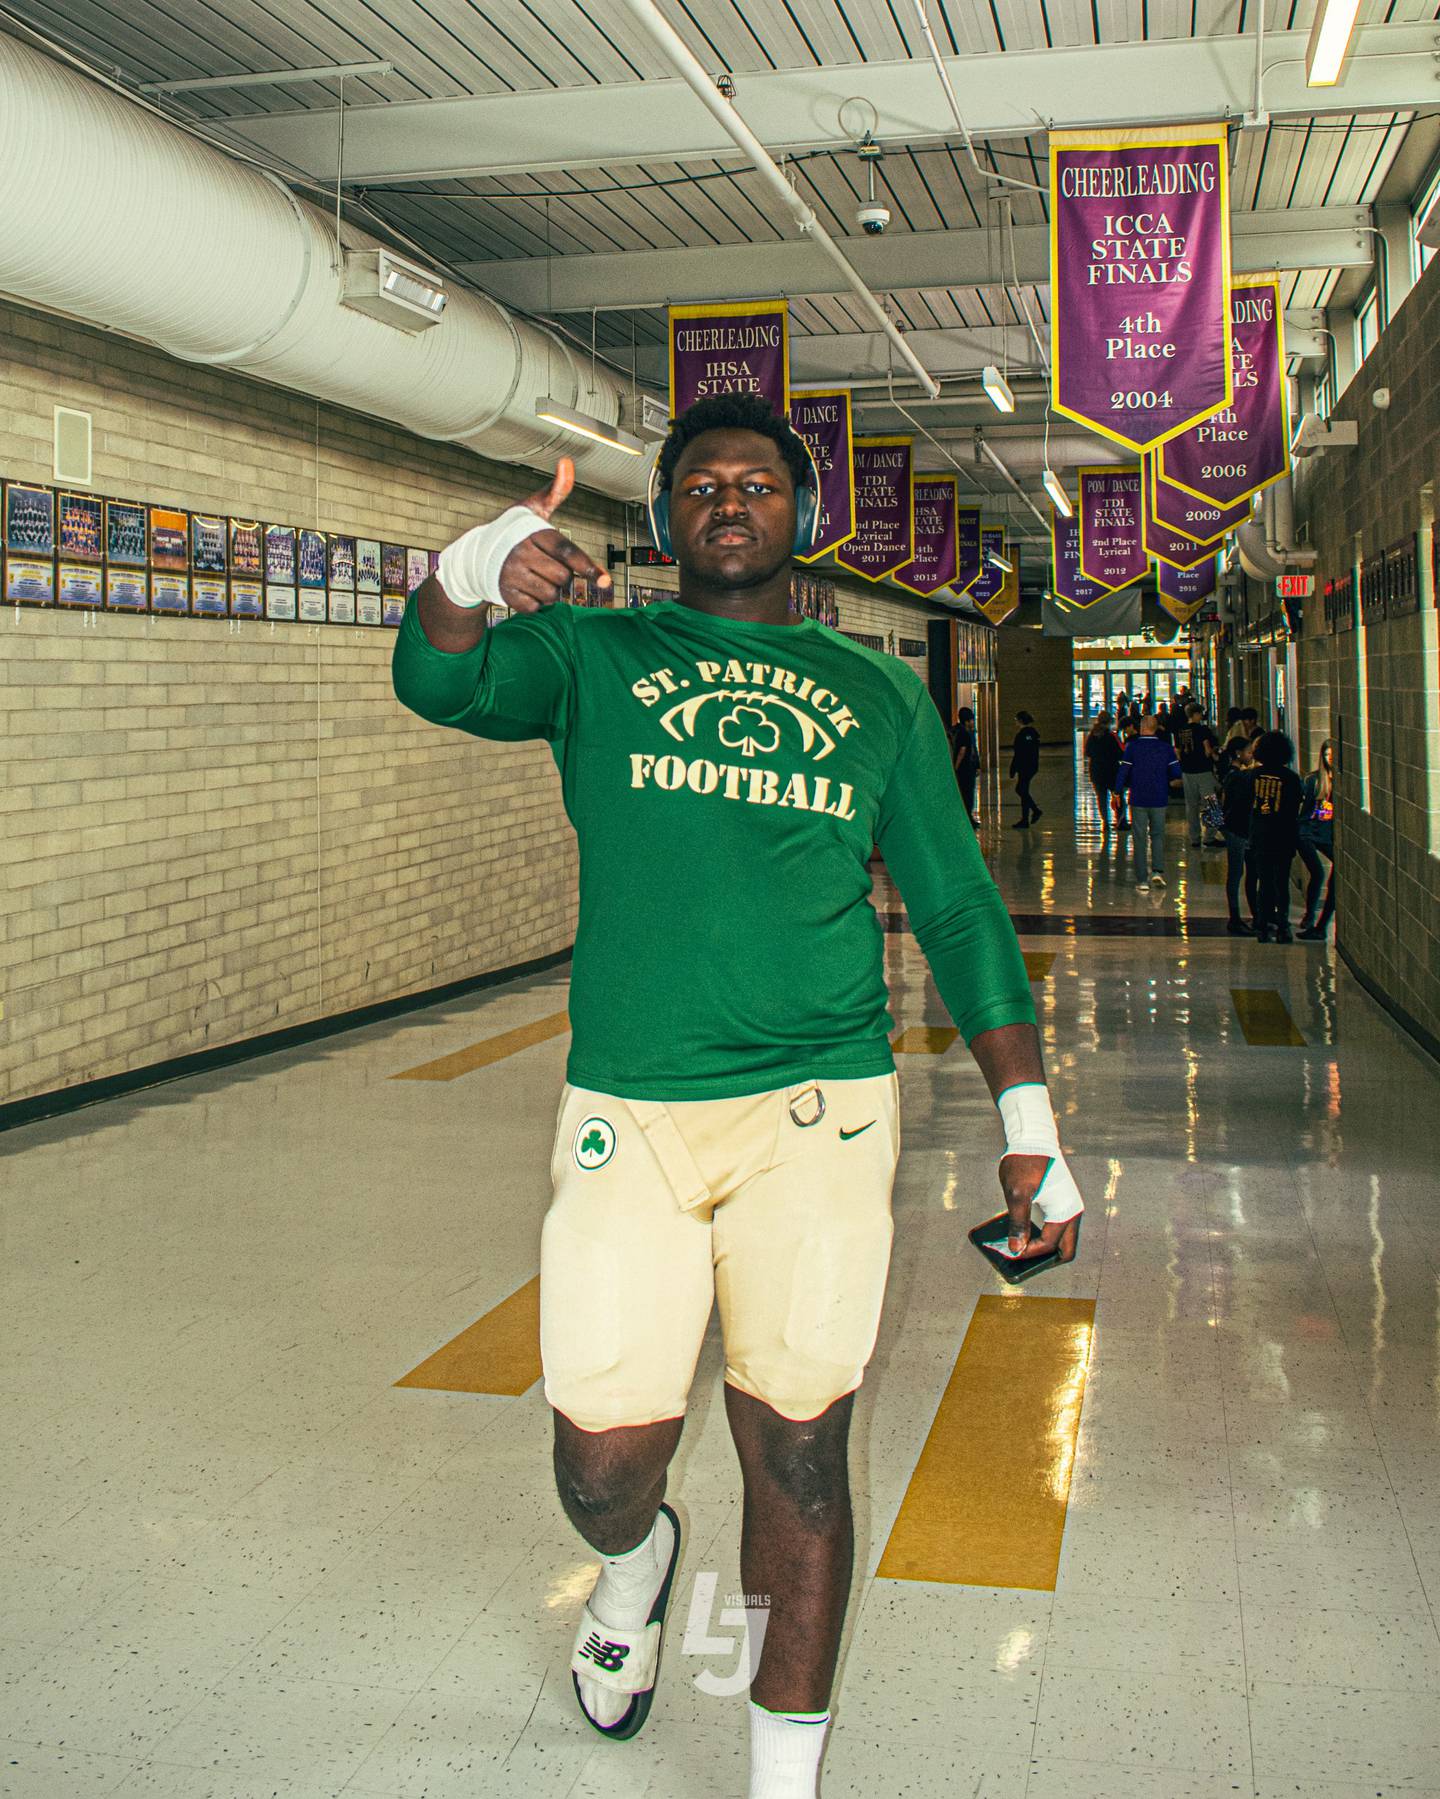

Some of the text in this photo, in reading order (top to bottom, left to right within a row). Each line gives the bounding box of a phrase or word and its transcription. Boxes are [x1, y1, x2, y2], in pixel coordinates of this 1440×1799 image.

[1061, 161, 1215, 198] CHEERLEADING
[1103, 213, 1175, 236] ICCA
[1092, 237, 1187, 260] STATE
[1087, 261, 1192, 285] FINALS
[1118, 312, 1161, 334] 4th
[676, 325, 780, 352] CHEERLEADING
[1105, 338, 1176, 359] Place
[705, 360, 752, 378] IHSA
[697, 377, 760, 395] STATE
[1110, 390, 1173, 410] 2004
[803, 405, 839, 424] DANCE
[803, 433, 819, 446] DI
[1197, 427, 1249, 442] Place
[873, 453, 904, 468] DANCE
[1201, 464, 1247, 479] 2006
[862, 475, 887, 486] TDI
[1112, 480, 1140, 492] DANCE
[854, 486, 897, 497] STATE
[856, 498, 898, 508] INALS
[1102, 499, 1125, 507] TDI
[1095, 508, 1133, 517] STATE
[1185, 510, 1221, 521] 2009
[872, 520, 900, 529] Place
[1094, 518, 1135, 528] FINALS
[857, 531, 893, 543] Lyrical
[1112, 538, 1137, 546] Place
[842, 541, 906, 557] Open Dance
[1099, 547, 1131, 558] Lyrical
[1169, 542, 1198, 552] 2011
[861, 555, 887, 563] 2011
[1282, 576, 1308, 596] EXIT
[631, 659, 861, 738] ST. PATRICK
[629, 753, 857, 822] FOOTBALL
